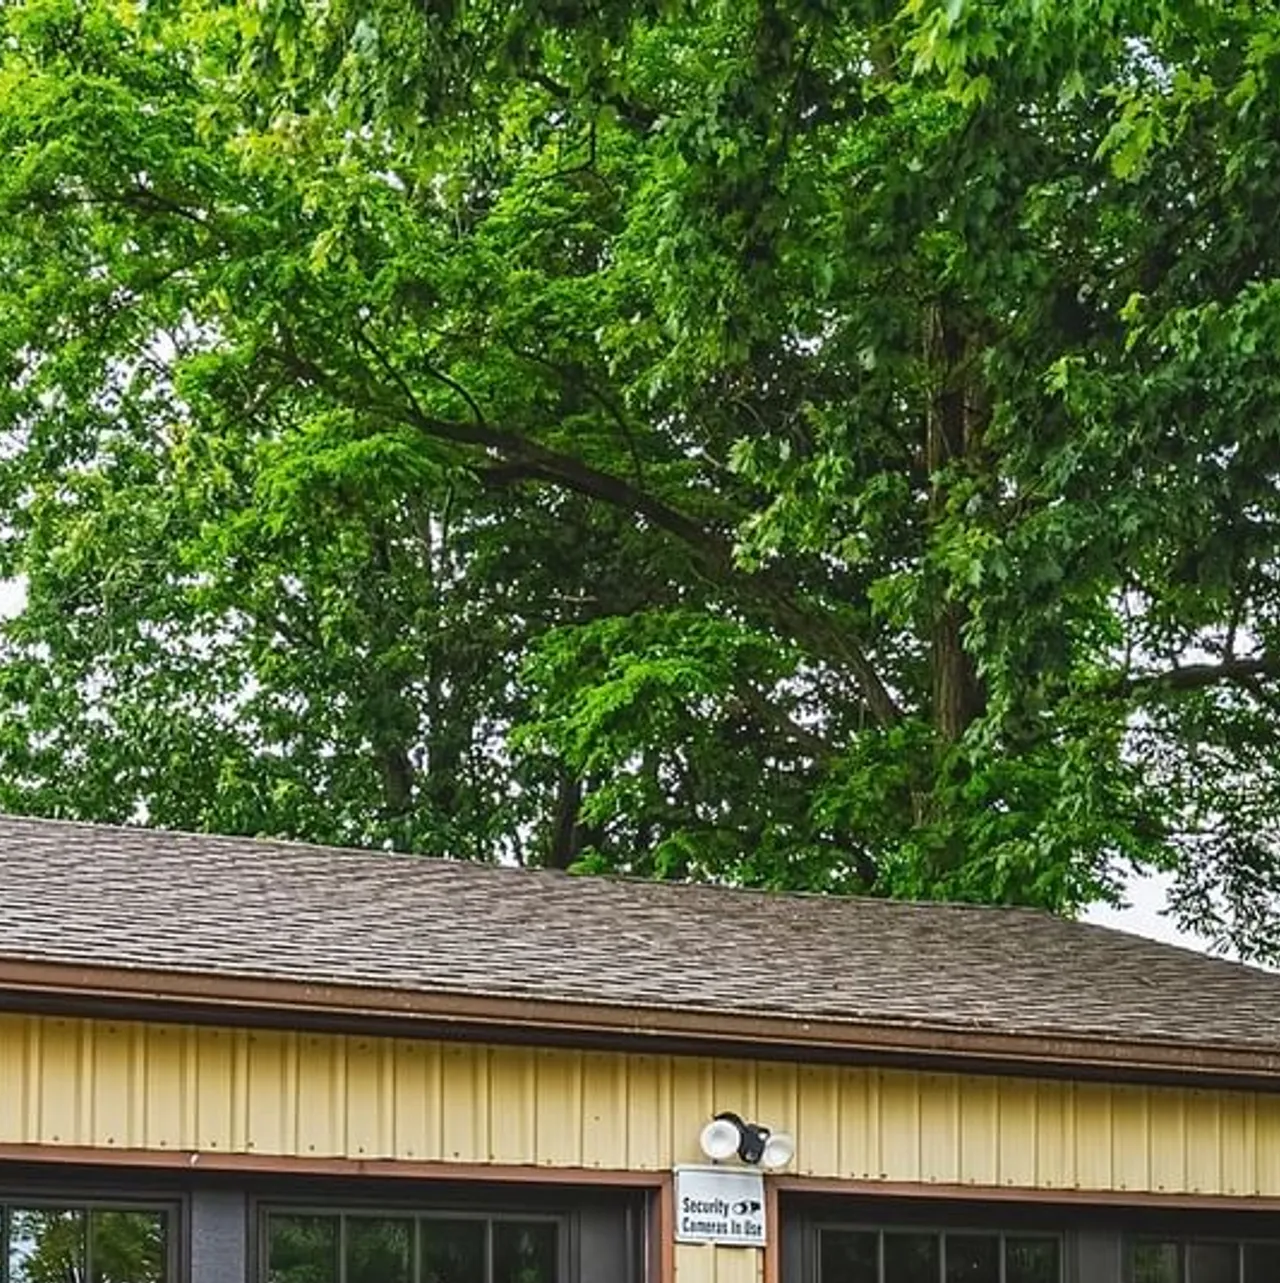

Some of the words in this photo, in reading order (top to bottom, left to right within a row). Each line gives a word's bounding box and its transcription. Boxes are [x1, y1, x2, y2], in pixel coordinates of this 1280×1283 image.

[682, 1197, 729, 1217] Security
[682, 1217, 728, 1234] Cameras
[731, 1220, 741, 1235] In
[745, 1220, 762, 1236] Use
